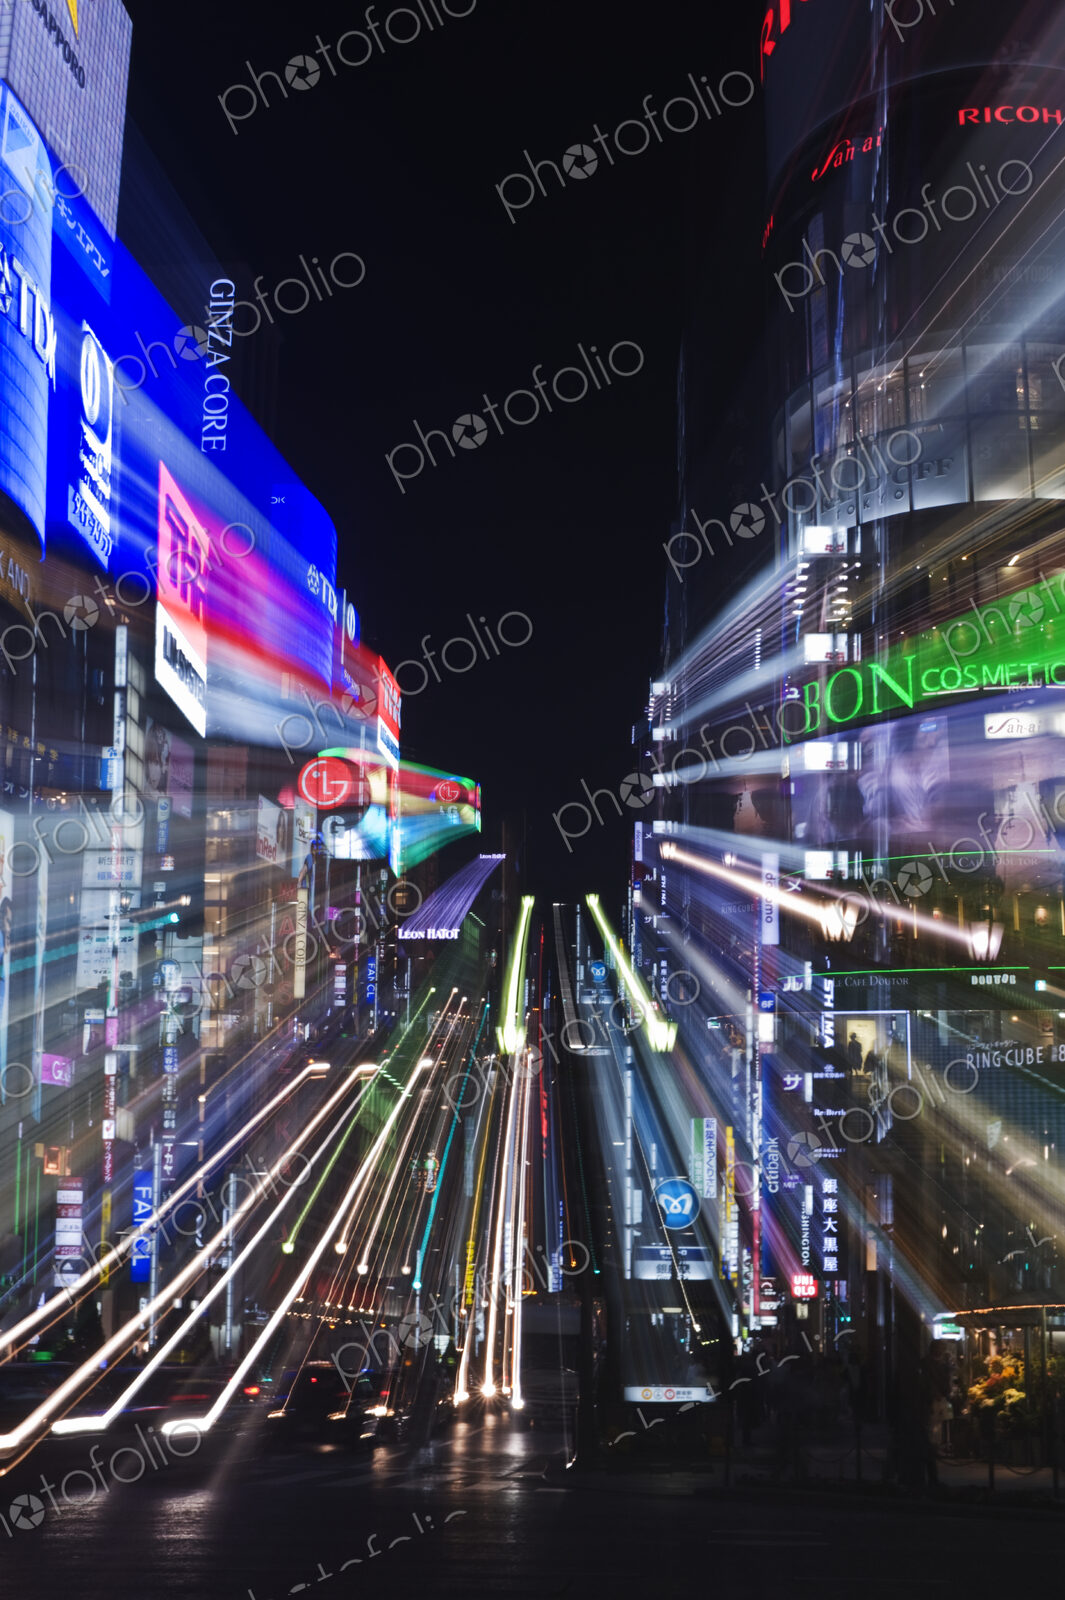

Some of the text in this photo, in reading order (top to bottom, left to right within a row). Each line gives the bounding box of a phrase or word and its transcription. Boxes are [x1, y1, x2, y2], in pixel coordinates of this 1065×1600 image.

[958, 105, 1062, 126] RICOH
[201, 279, 235, 453] GINZA CORE
[765, 873, 776, 924] domo
[966, 1052, 1001, 1070] RING
[1005, 1046, 1044, 1067] CUBE
[765, 1137, 779, 1193] citibank
[822, 1178, 838, 1271] 銀座大黒屋
[793, 1275, 813, 1284] UNI
[793, 1286, 816, 1296] QLO
